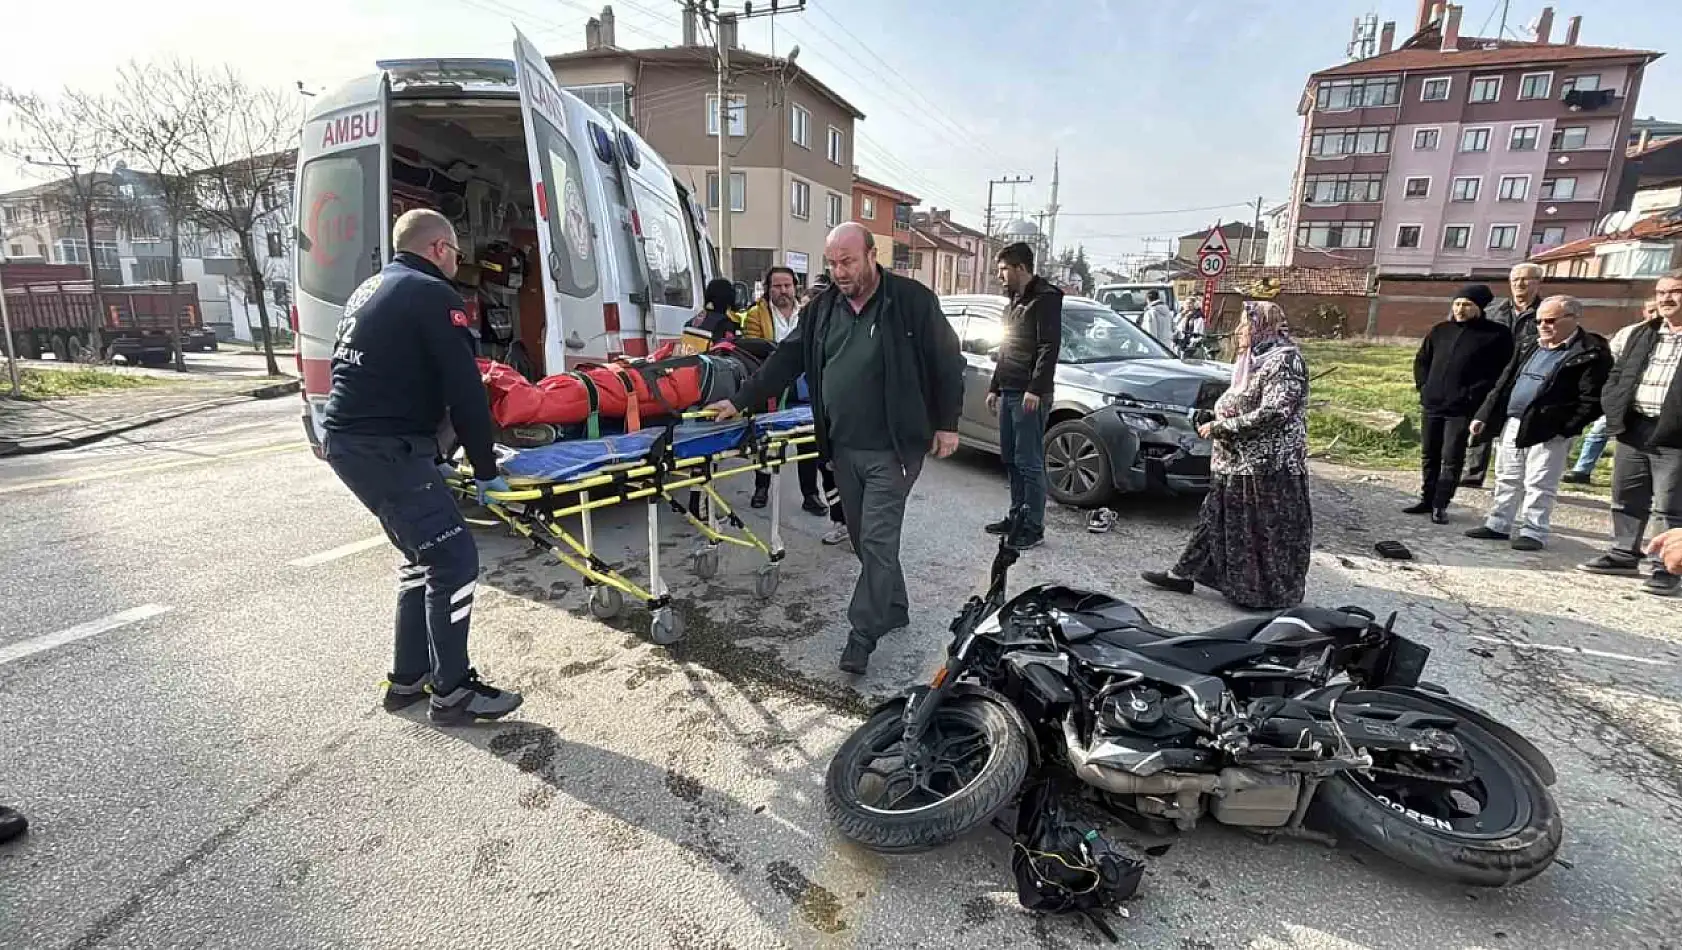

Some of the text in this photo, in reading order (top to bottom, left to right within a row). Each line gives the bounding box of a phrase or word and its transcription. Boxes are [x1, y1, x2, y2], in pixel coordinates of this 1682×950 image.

[321, 110, 378, 148] AMBU
[1205, 258, 1220, 271] 30
[1377, 795, 1453, 831] NS200
